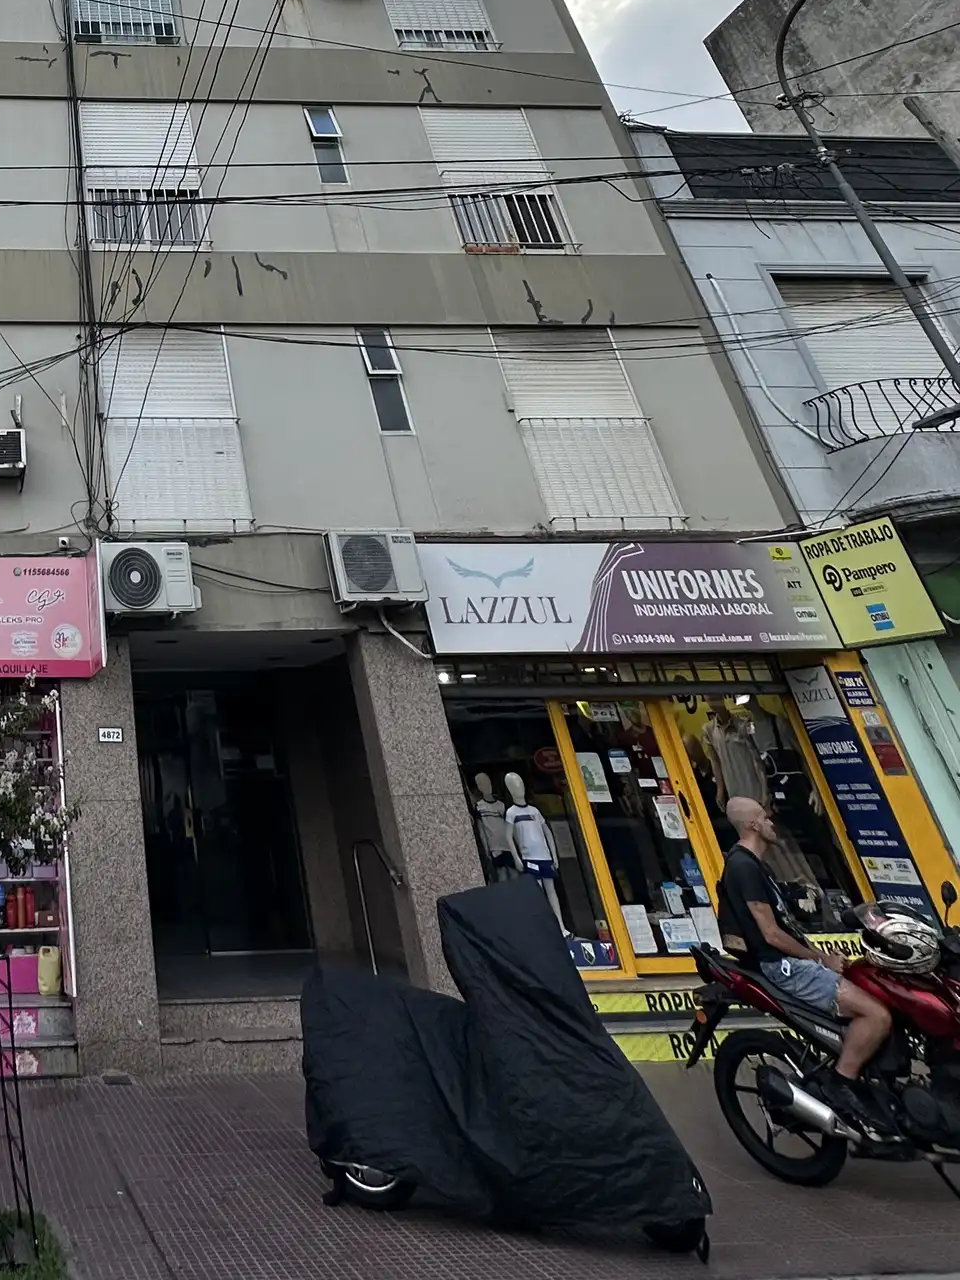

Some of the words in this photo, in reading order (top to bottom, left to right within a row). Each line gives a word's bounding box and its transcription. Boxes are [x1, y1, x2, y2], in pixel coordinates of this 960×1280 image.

[804, 542, 833, 560] ROPA
[834, 536, 847, 553] DE
[846, 524, 893, 549] TRABAJO
[841, 562, 896, 581] Pampero
[621, 569, 764, 600] UNIFORMES
[438, 596, 573, 624] LAZZUL
[633, 604, 720, 617] INDUMENTARIA
[721, 602, 773, 616] LABORAL
[25, 616, 43, 624] PRO
[621, 634, 676, 644] 11-3034-3906
[794, 688, 835, 703] LAZZUL
[101, 730, 121, 740] 4872
[816, 741, 858, 755] UNIFORMES
[645, 992, 696, 1012] ROPA
[669, 1032, 721, 1059] ROA
